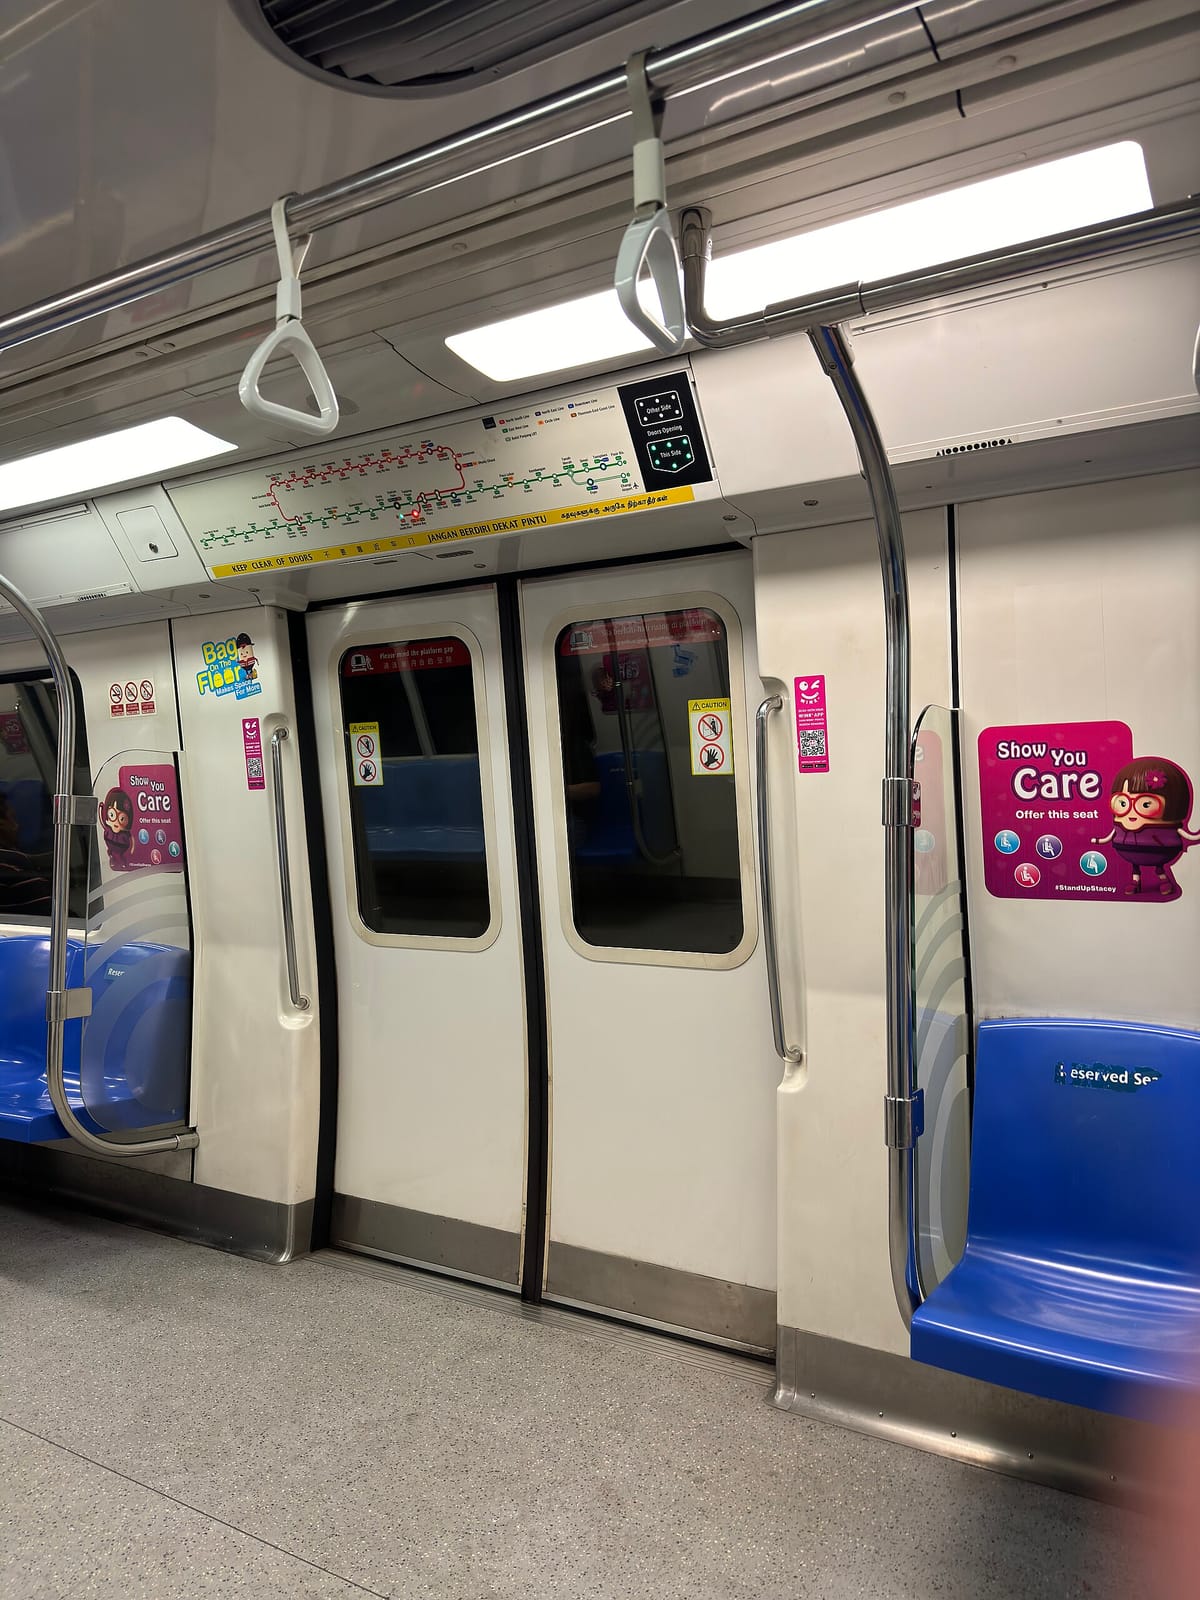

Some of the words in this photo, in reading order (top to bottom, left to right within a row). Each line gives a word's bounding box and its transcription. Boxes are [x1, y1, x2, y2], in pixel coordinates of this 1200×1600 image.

[661, 425, 683, 434] Opening
[427, 531, 458, 543] JANGAN
[459, 525, 491, 537] BERDIRI
[492, 520, 519, 532] DEKAT
[521, 514, 547, 527] PINTU
[231, 563, 248, 572] KEEP
[251, 560, 273, 570] CLEAR
[276, 557, 285, 565] OF
[288, 553, 313, 564] DOORS
[202, 639, 238, 665] Bag
[421, 647, 443, 656] platform
[444, 646, 454, 655] gap
[219, 659, 232, 668] The
[197, 665, 241, 694] Floor
[235, 680, 252, 689] Space
[236, 688, 245, 697] For
[246, 684, 260, 692] More
[997, 741, 1047, 759] Show
[1050, 749, 1086, 766] You
[130, 775, 149, 786] Show
[150, 781, 165, 792] You
[1013, 767, 1100, 800] Care
[137, 791, 171, 812] Care
[1016, 810, 1045, 819] Offer
[1048, 809, 1070, 819] this
[1073, 809, 1098, 819] seat
[1055, 884, 1117, 893] #StandUpStacey
